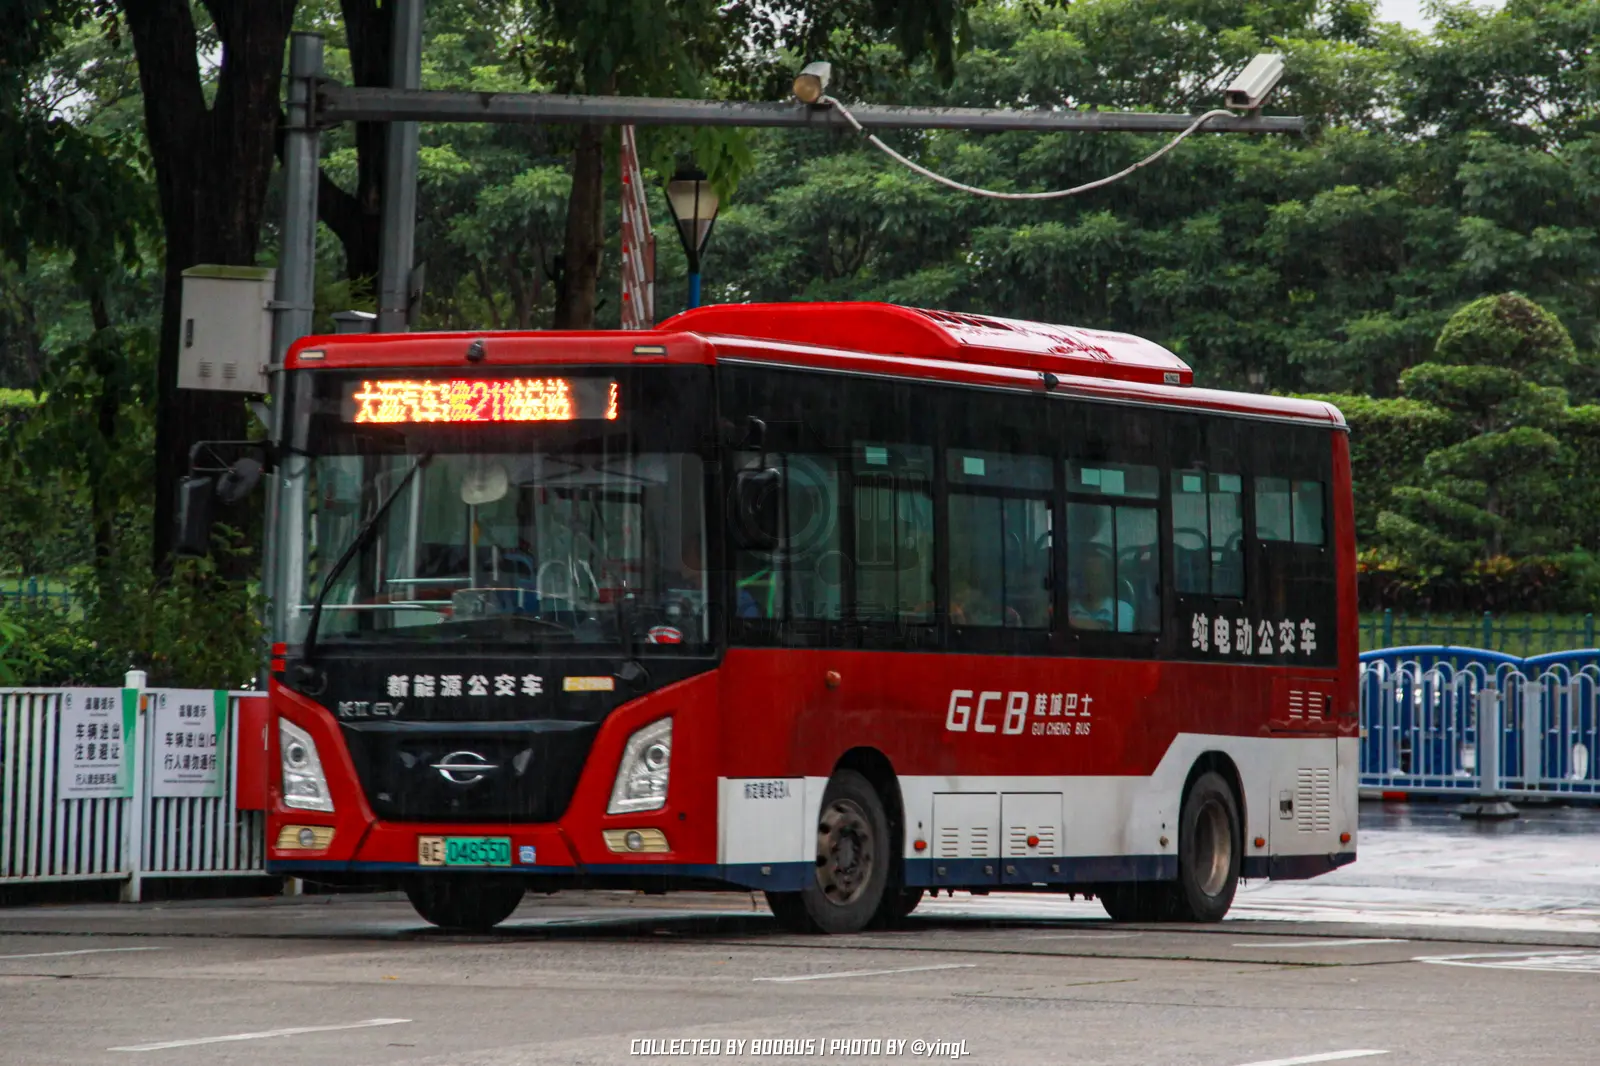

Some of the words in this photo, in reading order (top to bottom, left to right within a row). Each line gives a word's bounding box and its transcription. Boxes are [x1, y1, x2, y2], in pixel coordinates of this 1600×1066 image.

[1192, 613, 1317, 655] 纯电动公交车
[387, 674, 543, 698] 新能源公交车
[946, 690, 1029, 735] GCB
[1034, 693, 1093, 716] 桂城巴士
[75, 723, 120, 740] 车辆进出
[1075, 722, 1091, 736] BUS
